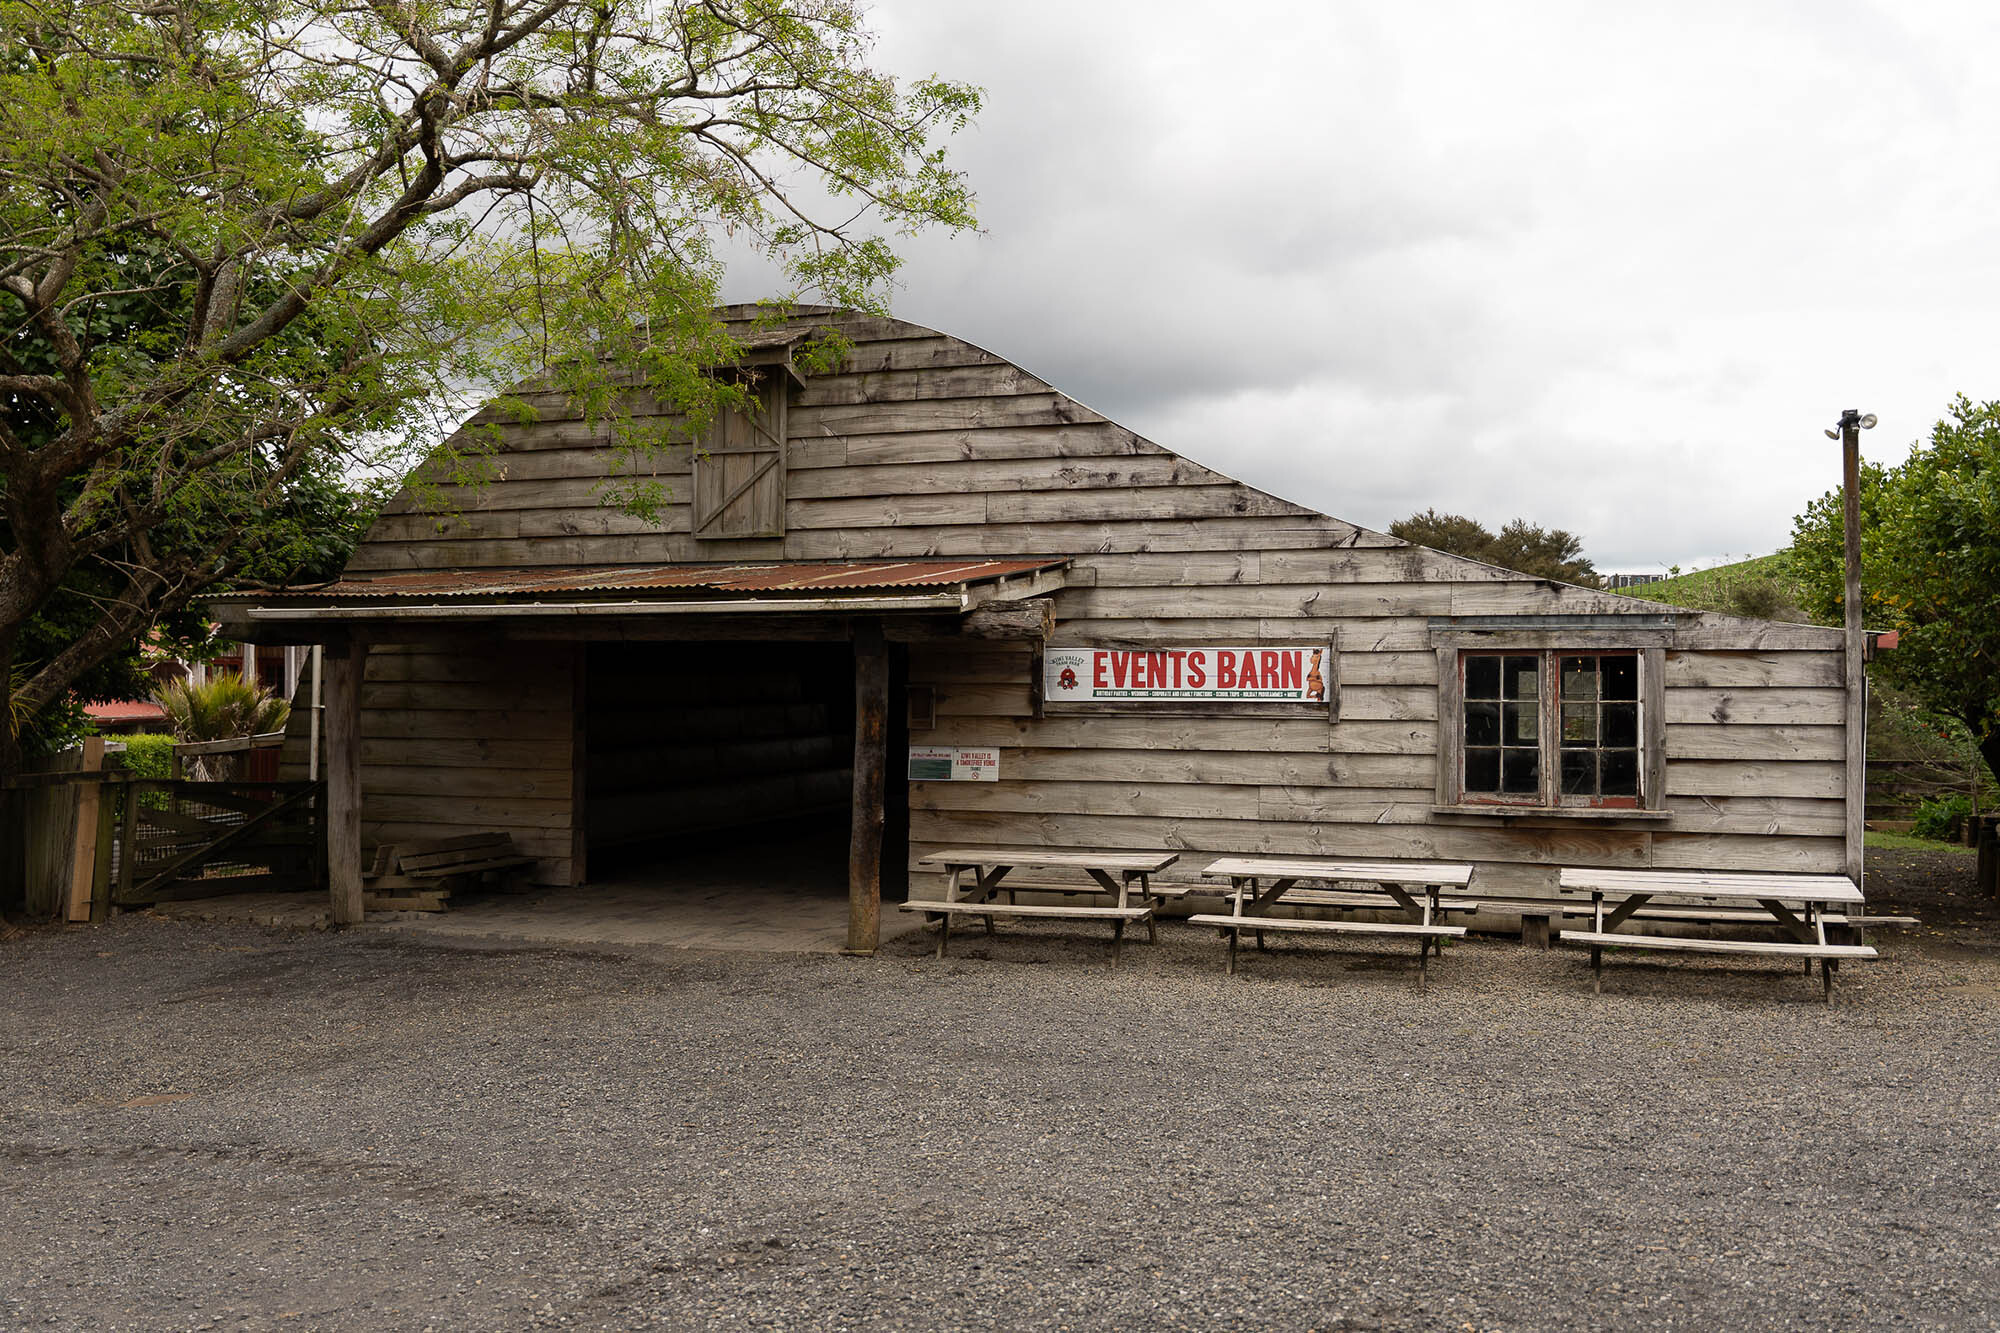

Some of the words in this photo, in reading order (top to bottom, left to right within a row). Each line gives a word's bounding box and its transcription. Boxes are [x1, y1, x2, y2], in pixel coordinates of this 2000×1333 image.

[1064, 656, 1084, 664] VALLEY
[1093, 651, 1206, 688] EVENTS
[1217, 651, 1302, 689] BARN
